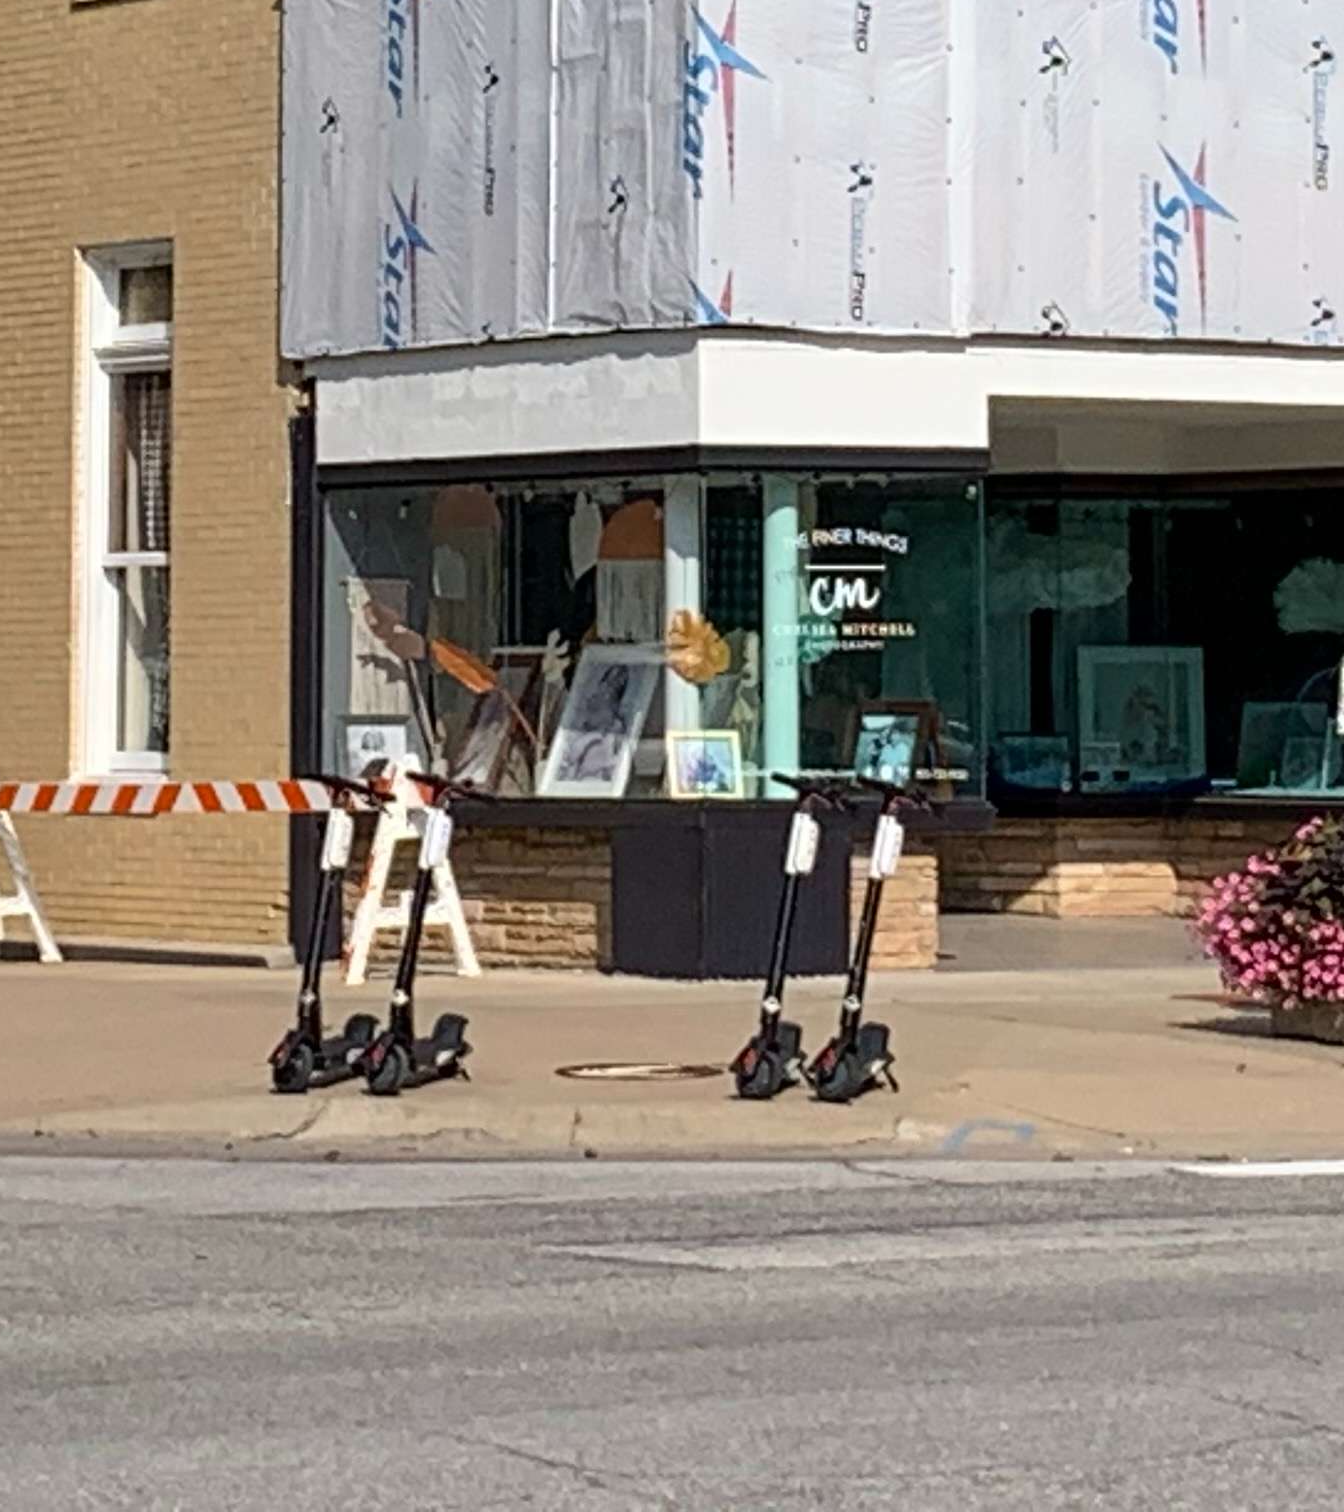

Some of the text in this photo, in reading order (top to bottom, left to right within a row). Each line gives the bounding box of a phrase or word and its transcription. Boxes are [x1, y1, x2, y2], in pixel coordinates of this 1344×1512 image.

[682, 39, 718, 201] Star
[1154, 181, 1190, 336] Star
[855, 527, 909, 555] THINGS
